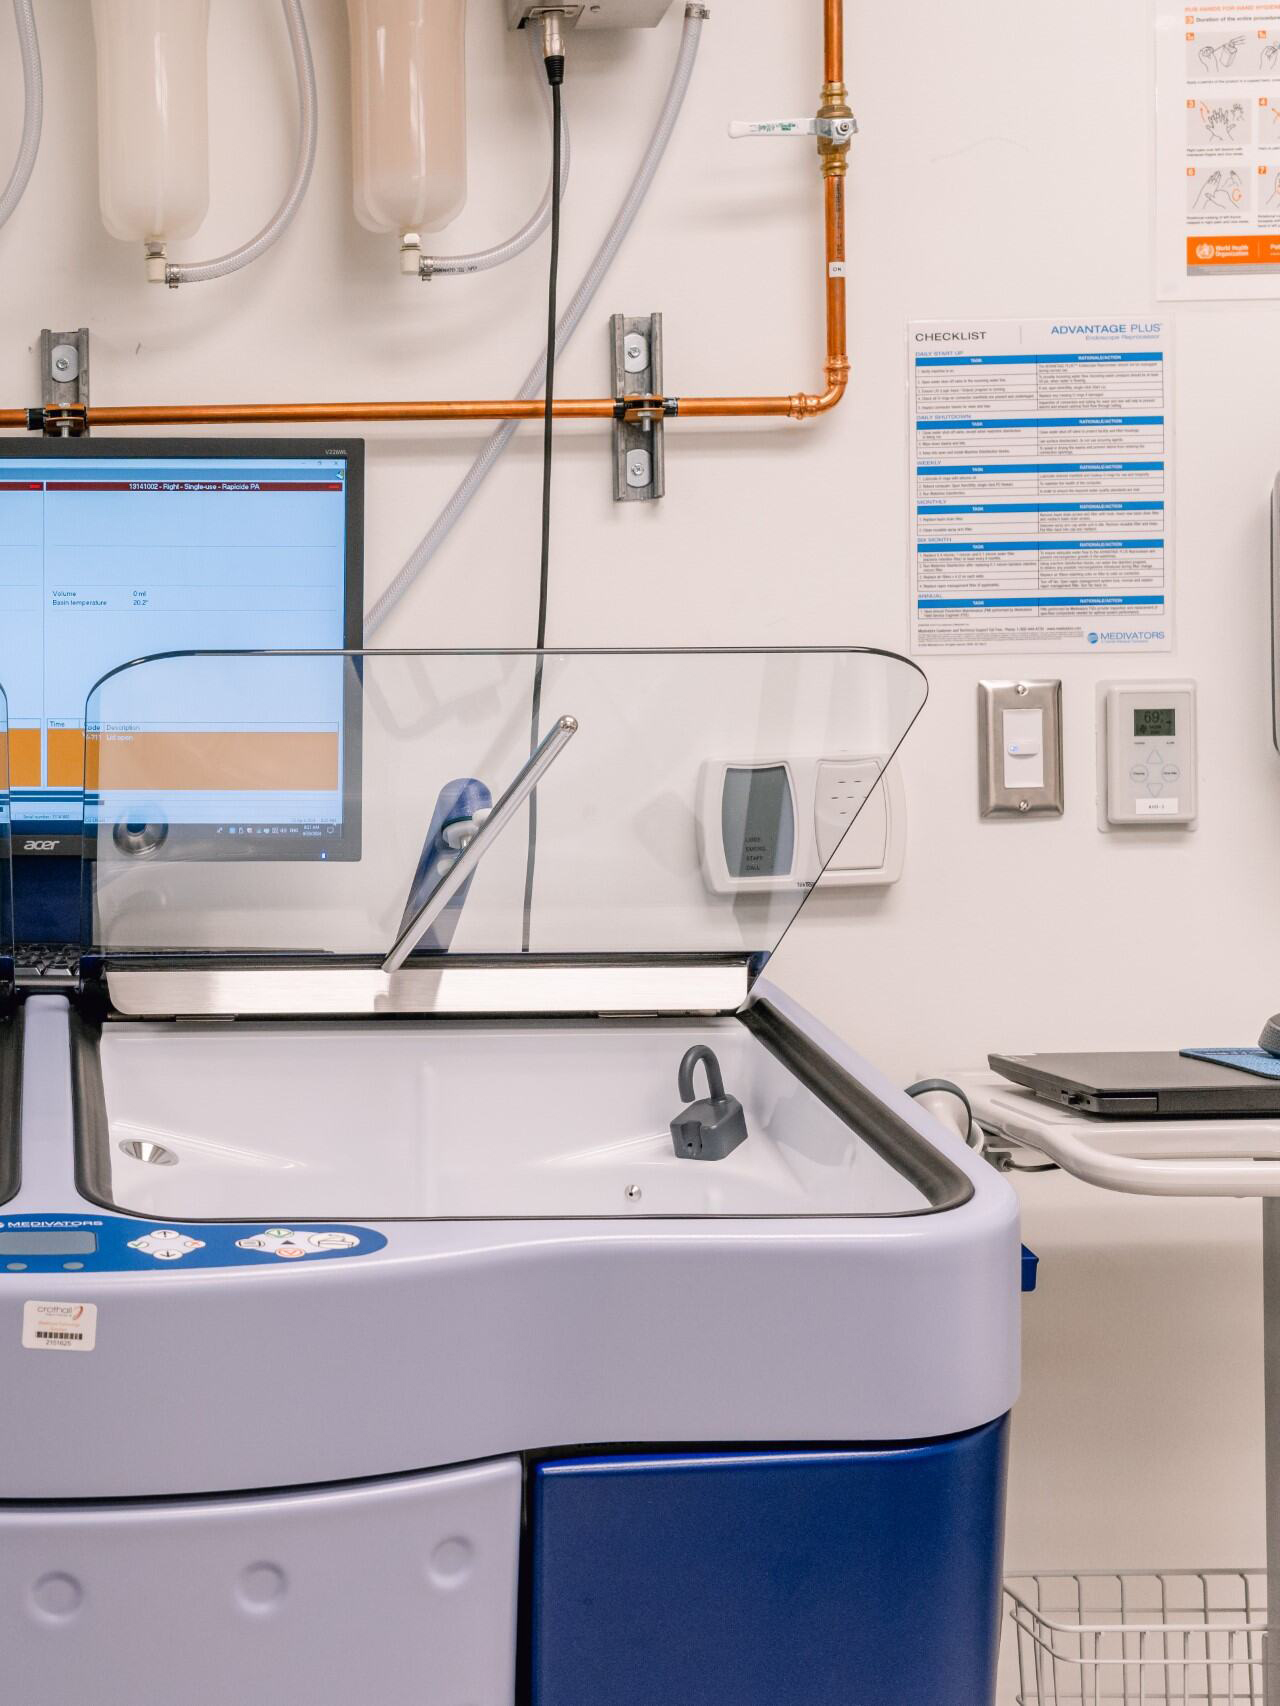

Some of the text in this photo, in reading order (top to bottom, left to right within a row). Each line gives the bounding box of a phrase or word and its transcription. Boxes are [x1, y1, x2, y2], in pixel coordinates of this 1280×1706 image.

[1051, 323, 1161, 334] ADVANTAGE PLUS
[915, 331, 987, 342] CHECKLIST
[163, 483, 180, 491] Right
[184, 483, 217, 491] Single-use
[222, 483, 249, 491] Rapicide
[1100, 631, 1165, 640] MEDIVATORS
[1144, 711, 1160, 723] 69
[24, 840, 60, 850] acer
[7, 1220, 104, 1229] MEDIVATORS
[37, 1305, 73, 1314] crothall
